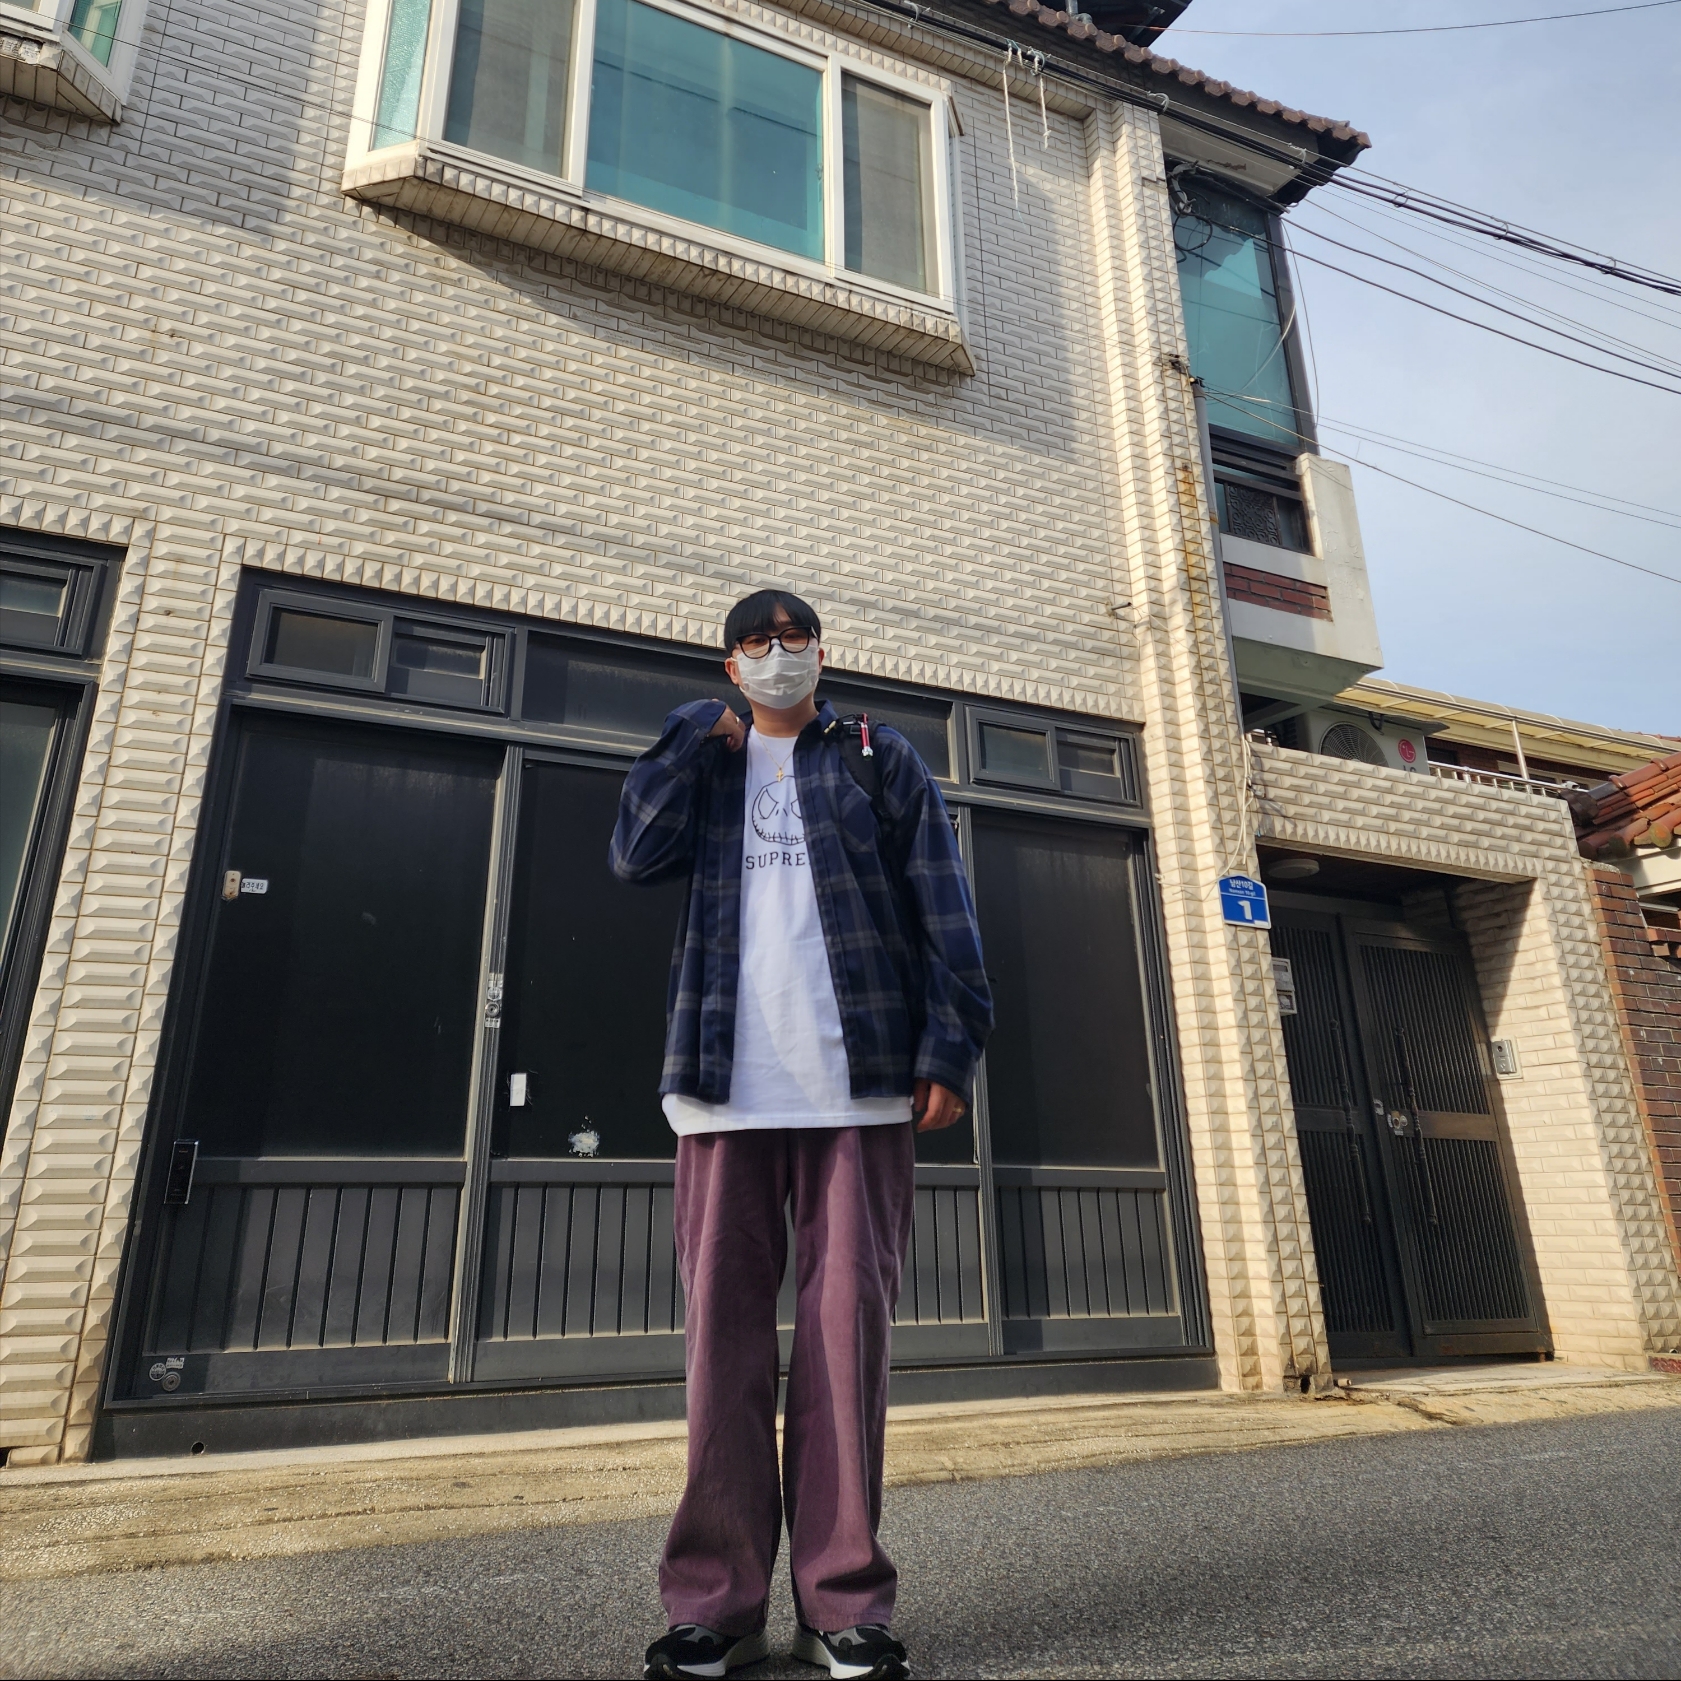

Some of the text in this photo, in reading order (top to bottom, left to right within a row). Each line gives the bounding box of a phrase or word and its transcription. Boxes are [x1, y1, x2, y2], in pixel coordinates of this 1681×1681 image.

[745, 851, 807, 870] SUPRE
[1229, 879, 1254, 891] 남산10길
[1237, 900, 1252, 920] 1
